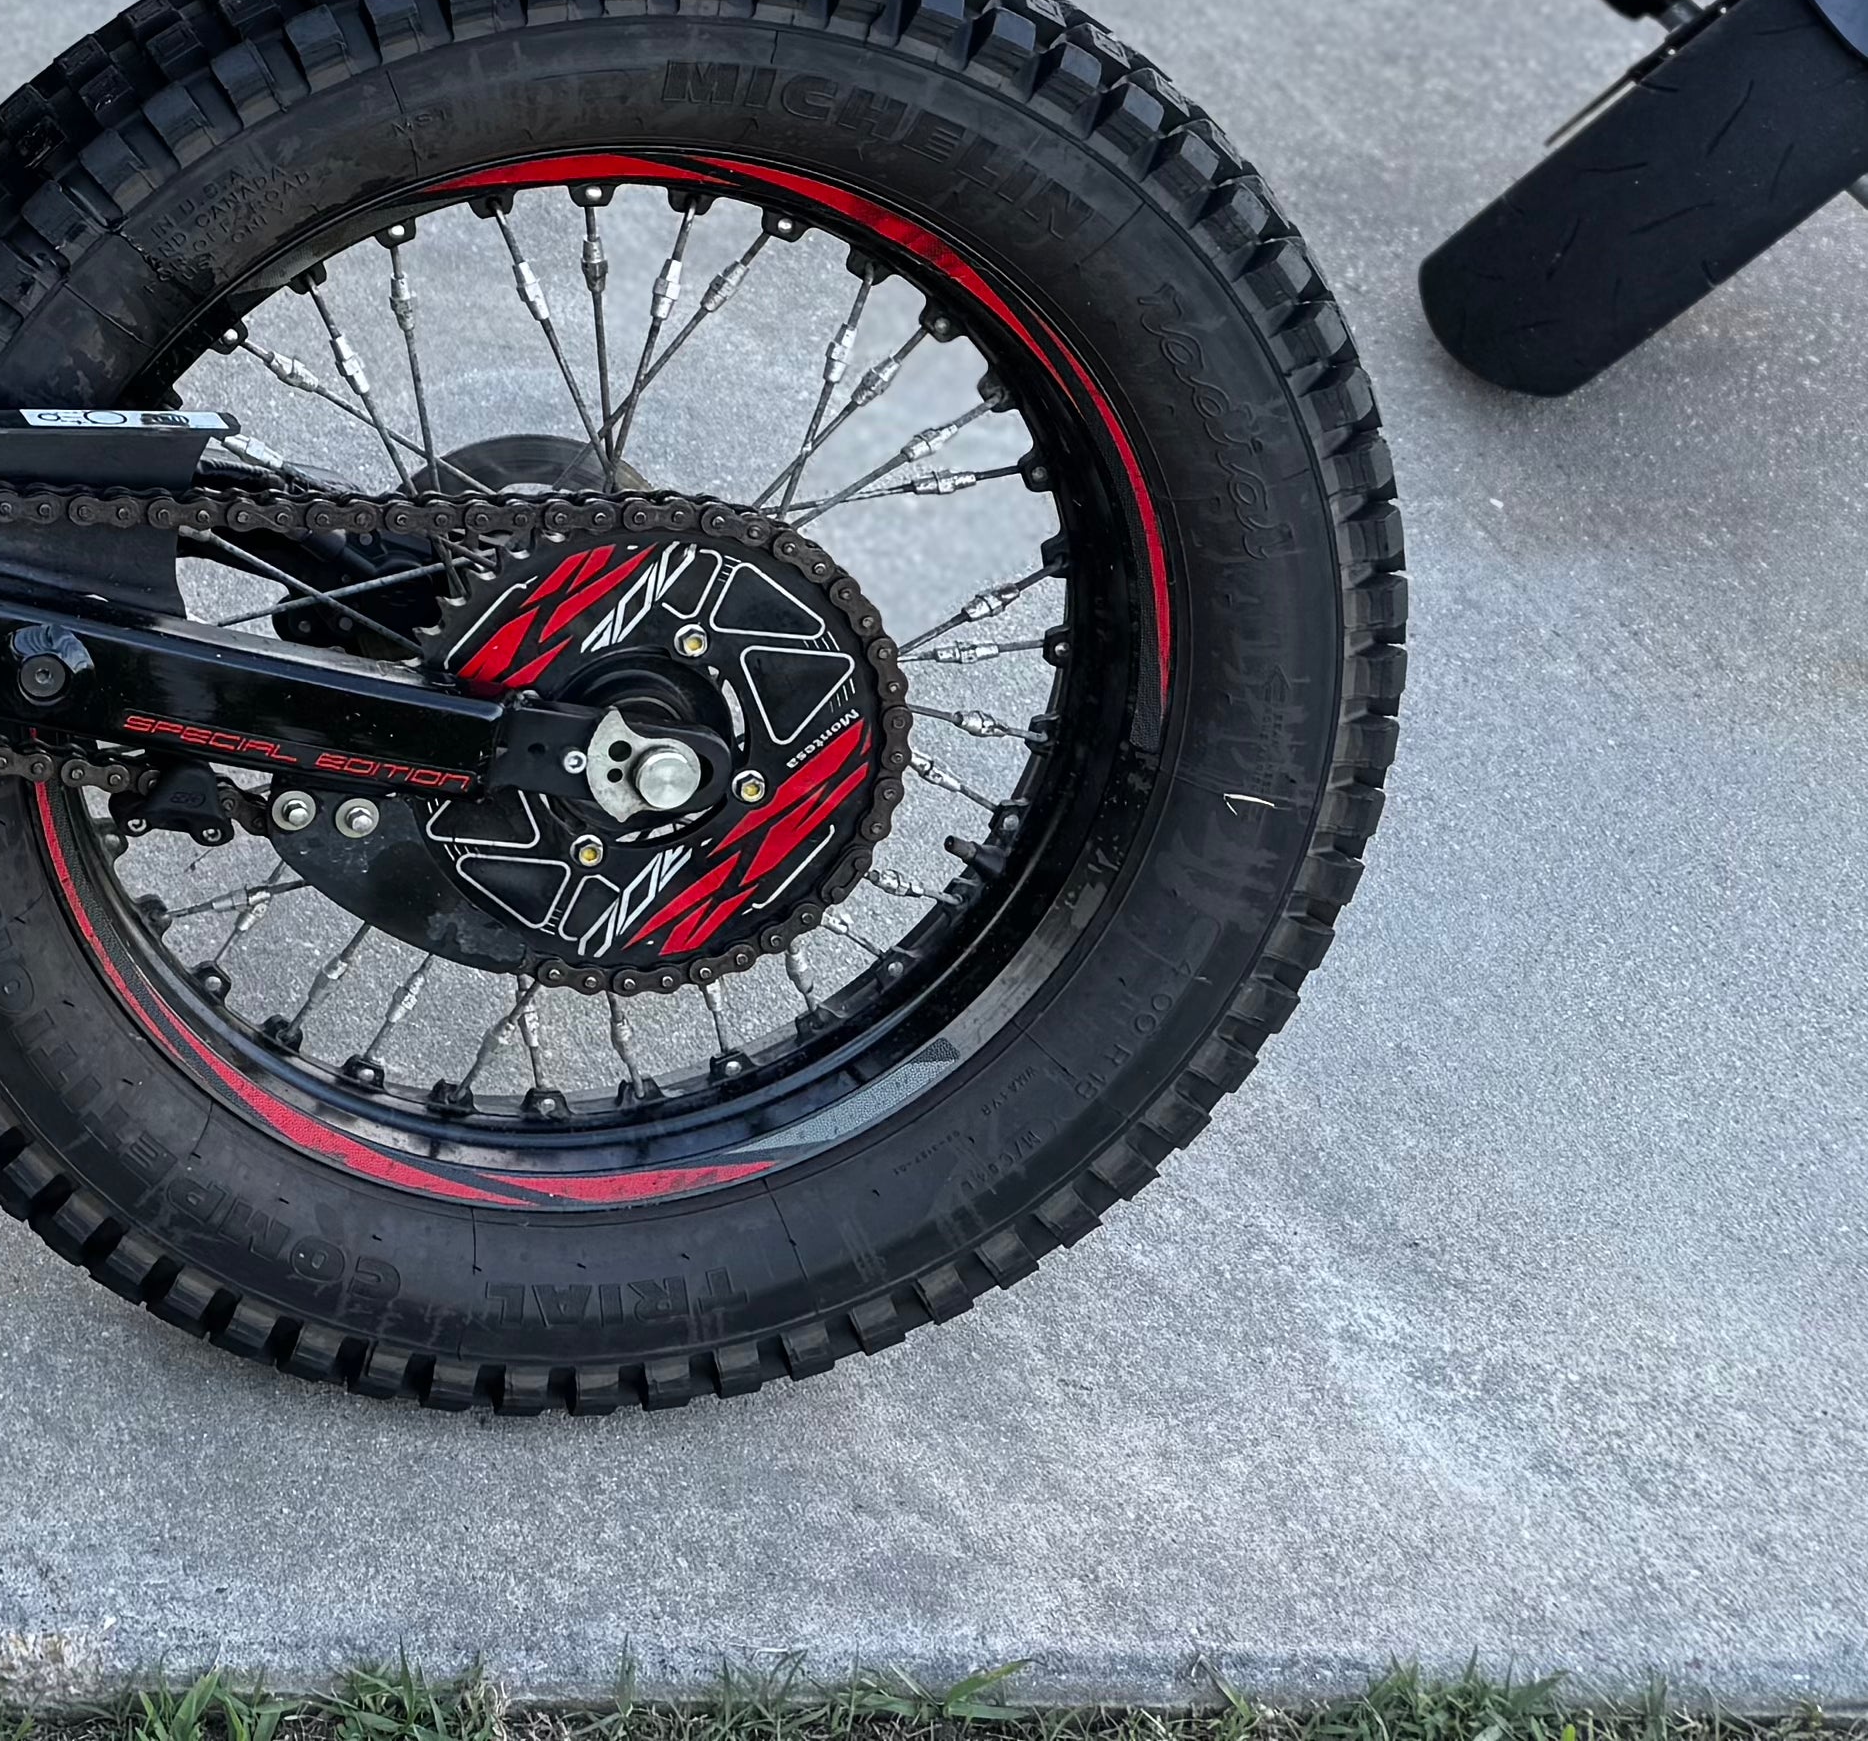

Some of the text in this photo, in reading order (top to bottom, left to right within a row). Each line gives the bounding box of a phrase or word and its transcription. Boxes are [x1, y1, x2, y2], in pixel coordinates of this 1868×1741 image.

[663, 60, 1088, 244] MICHELIN
[122, 714, 472, 793] SPECIAL EDITION
[785, 707, 860, 770] Montesa
[485, 1266, 750, 1329] TRIAL
